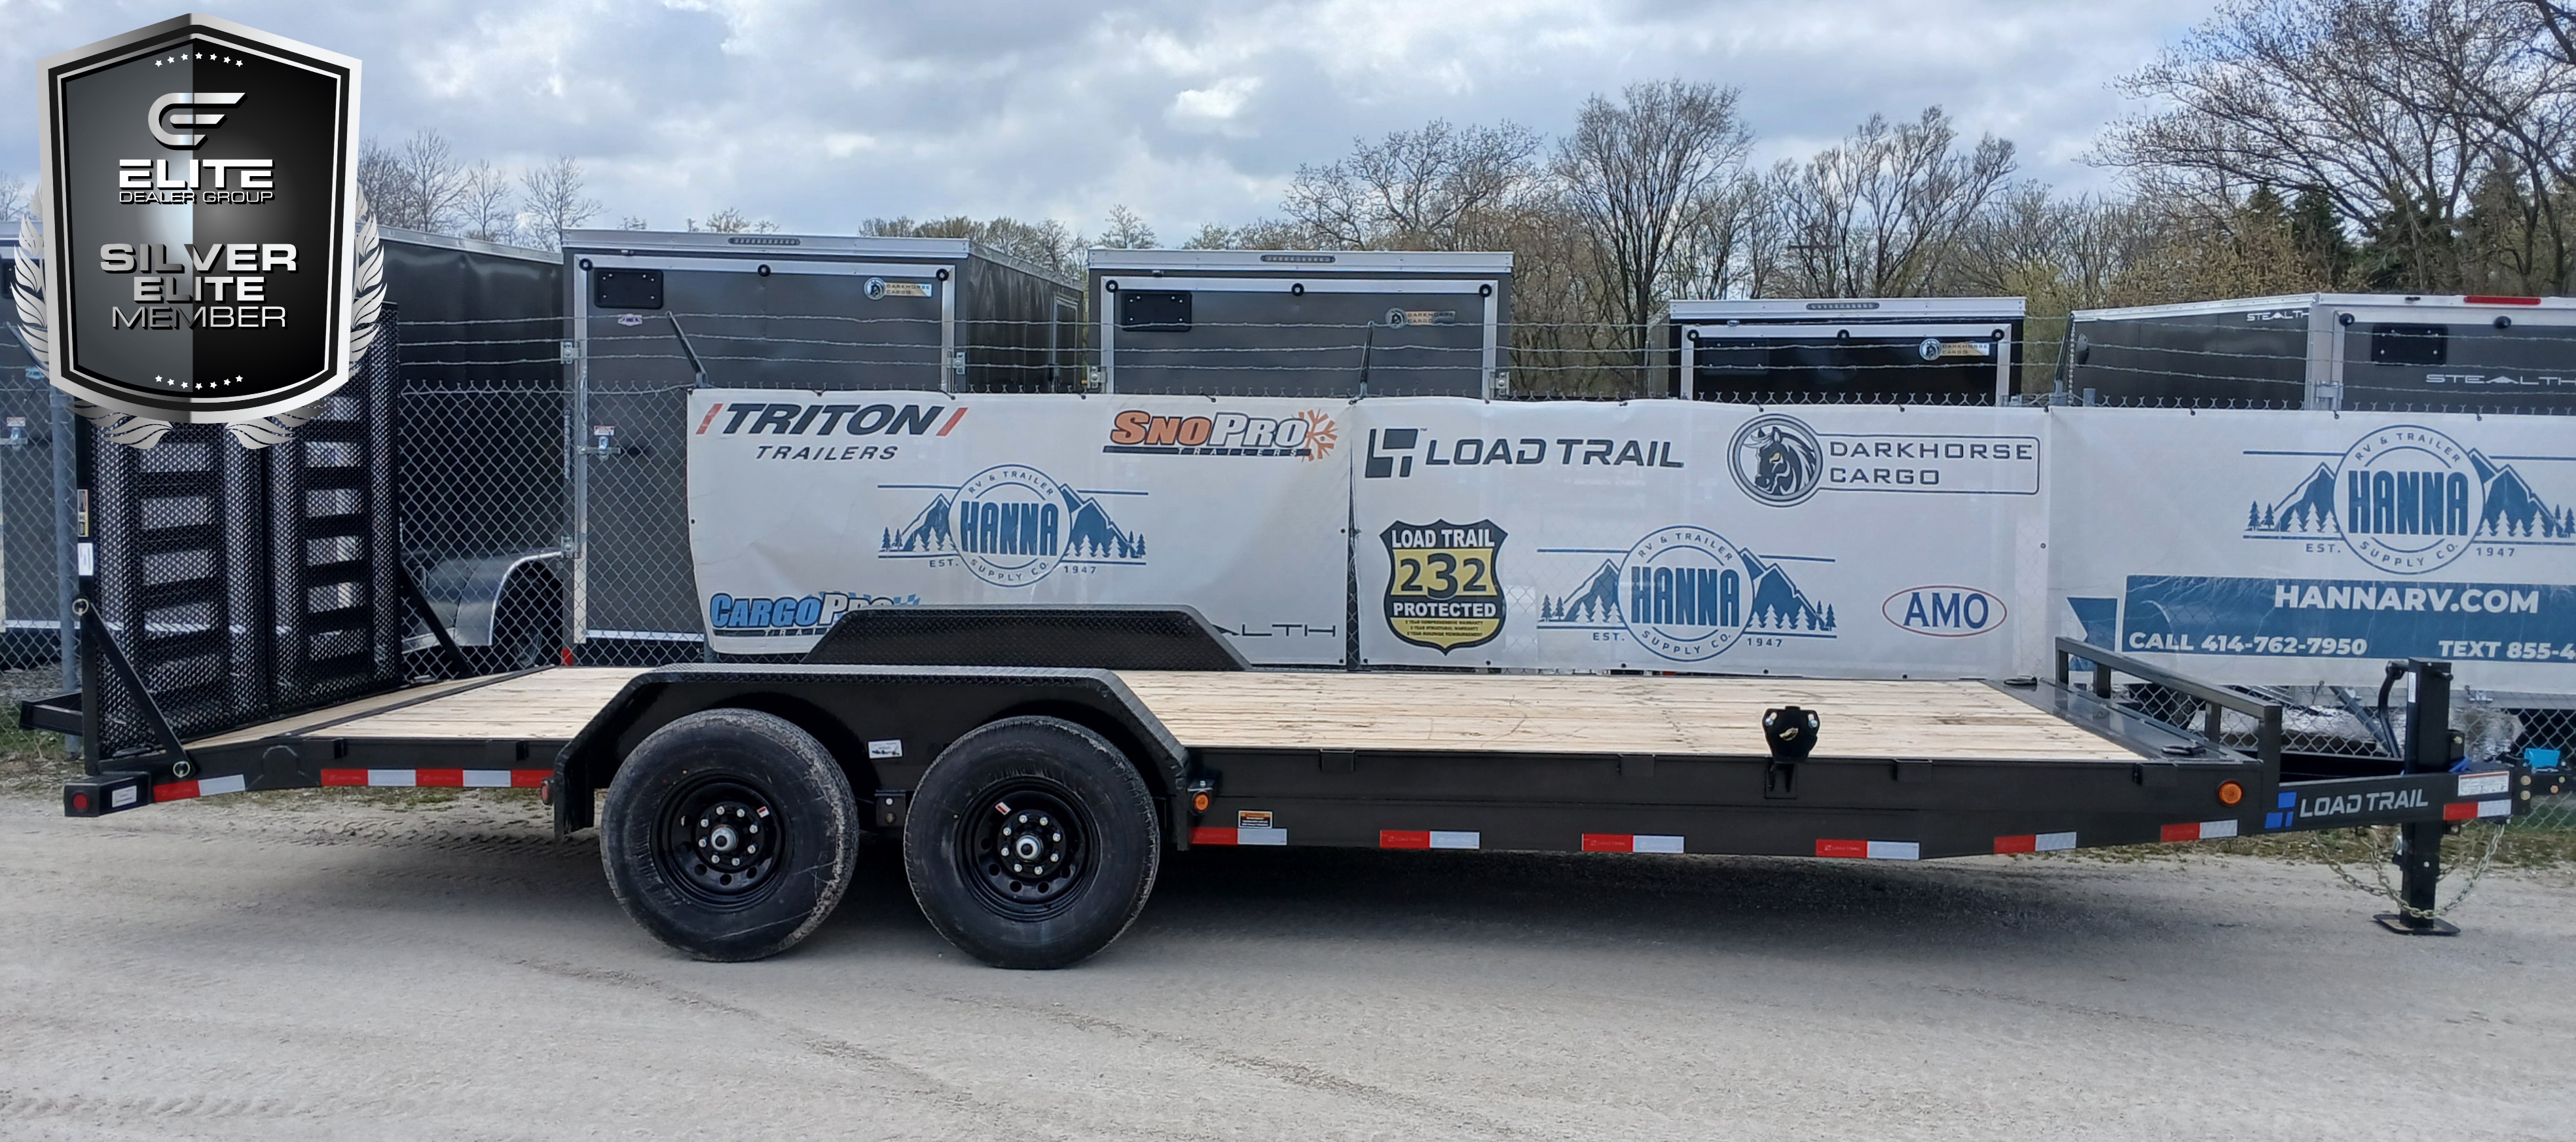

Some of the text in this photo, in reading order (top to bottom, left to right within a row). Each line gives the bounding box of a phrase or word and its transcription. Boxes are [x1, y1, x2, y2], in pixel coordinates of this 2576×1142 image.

[722, 403, 945, 436] TRITON
[755, 445, 898, 460] TRAILERS
[1178, 448, 1297, 457] TRAILERS
[1425, 438, 1684, 468] LOAD TRAIL
[1830, 441, 2033, 460] DARKHORSE
[2355, 432, 2461, 463] RV & TRAILER
[968, 481, 982, 494] RV
[1003, 471, 1054, 496] TRAILER
[1830, 468, 1940, 485] CARGO
[2348, 470, 2469, 536] HANNA
[960, 500, 1059, 556] HANNA
[1391, 529, 1495, 548] LOAD TRAIL
[1638, 543, 1653, 558] RV
[1675, 532, 1733, 561] TRAILER
[2306, 543, 2341, 554] EST.
[2359, 541, 2424, 567] SUPPLY
[2476, 547, 2516, 557] 1947
[929, 559, 959, 568] EST.
[970, 559, 1021, 581] SUPPLY
[1064, 565, 1097, 575] 1947
[1400, 553, 1487, 600] 232
[1631, 566, 1740, 627] HANNA
[2274, 585, 2539, 614] HANNARV.COM
[1393, 602, 1497, 617] PROTECTED
[1903, 591, 1989, 629] AMO
[1592, 631, 1625, 641] EST.
[1642, 630, 1731, 655] SUPPLY CO.
[1746, 637, 1784, 648] 1947
[2129, 632, 2367, 655] CALL 414-762-7950
[2438, 640, 2576, 660] TEXT 855-4
[2299, 788, 2429, 818] LOAD TRAIL
